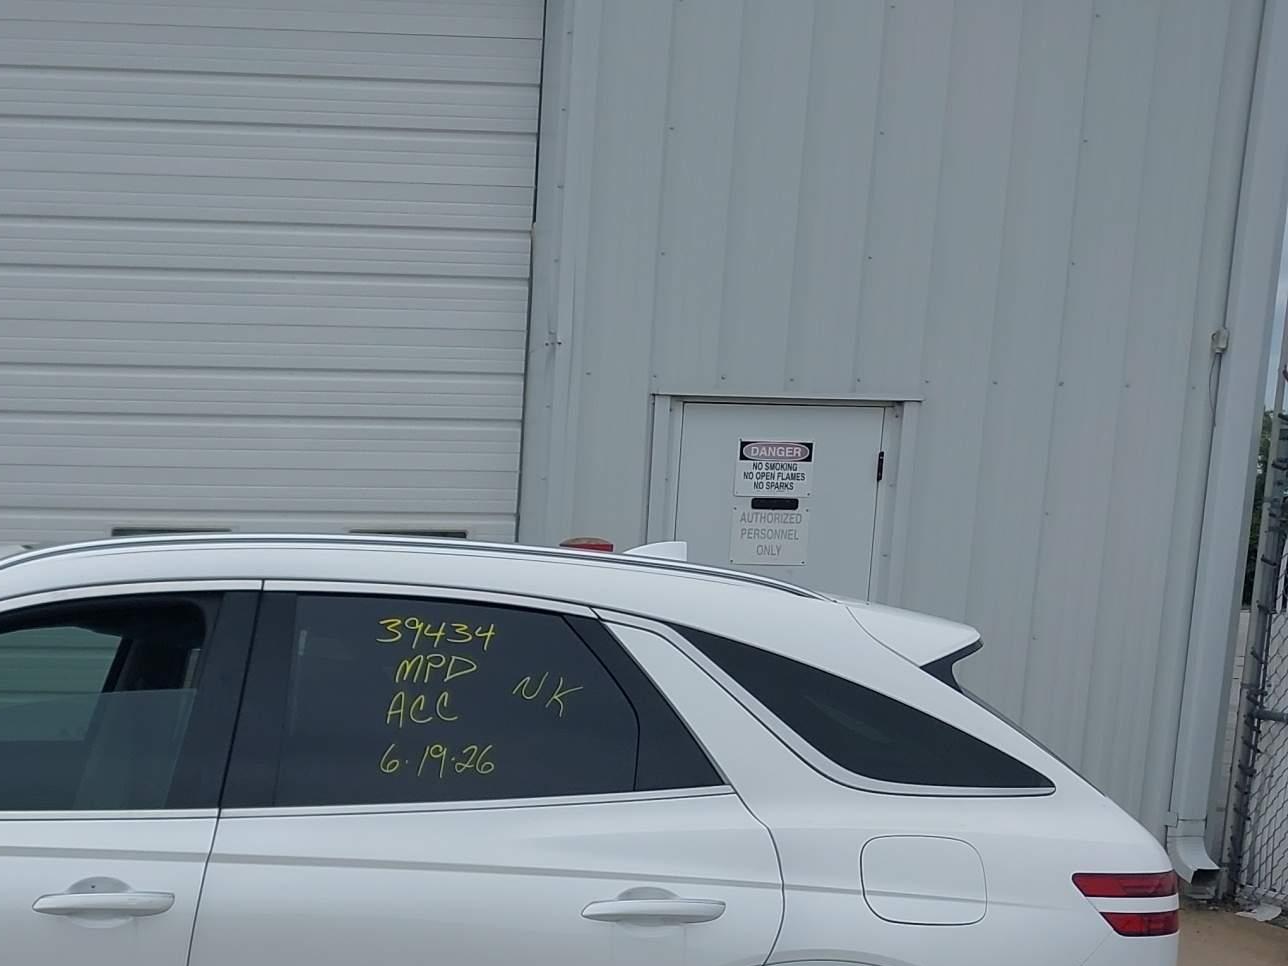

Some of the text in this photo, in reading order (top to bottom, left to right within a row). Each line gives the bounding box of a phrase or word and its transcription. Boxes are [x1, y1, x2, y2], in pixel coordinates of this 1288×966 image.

[751, 446, 802, 457] DANGER
[752, 462, 798, 471] NO SMOKING
[743, 472, 805, 481] NO OPEN FLAMES
[754, 481, 794, 490] NO SPARKS
[740, 512, 802, 524] AUTHORIZED
[740, 528, 799, 540] PERSONNEL
[756, 544, 782, 556] ONLY
[376, 617, 495, 650] 39434
[395, 653, 477, 683] MPD
[386, 691, 458, 728] ACC
